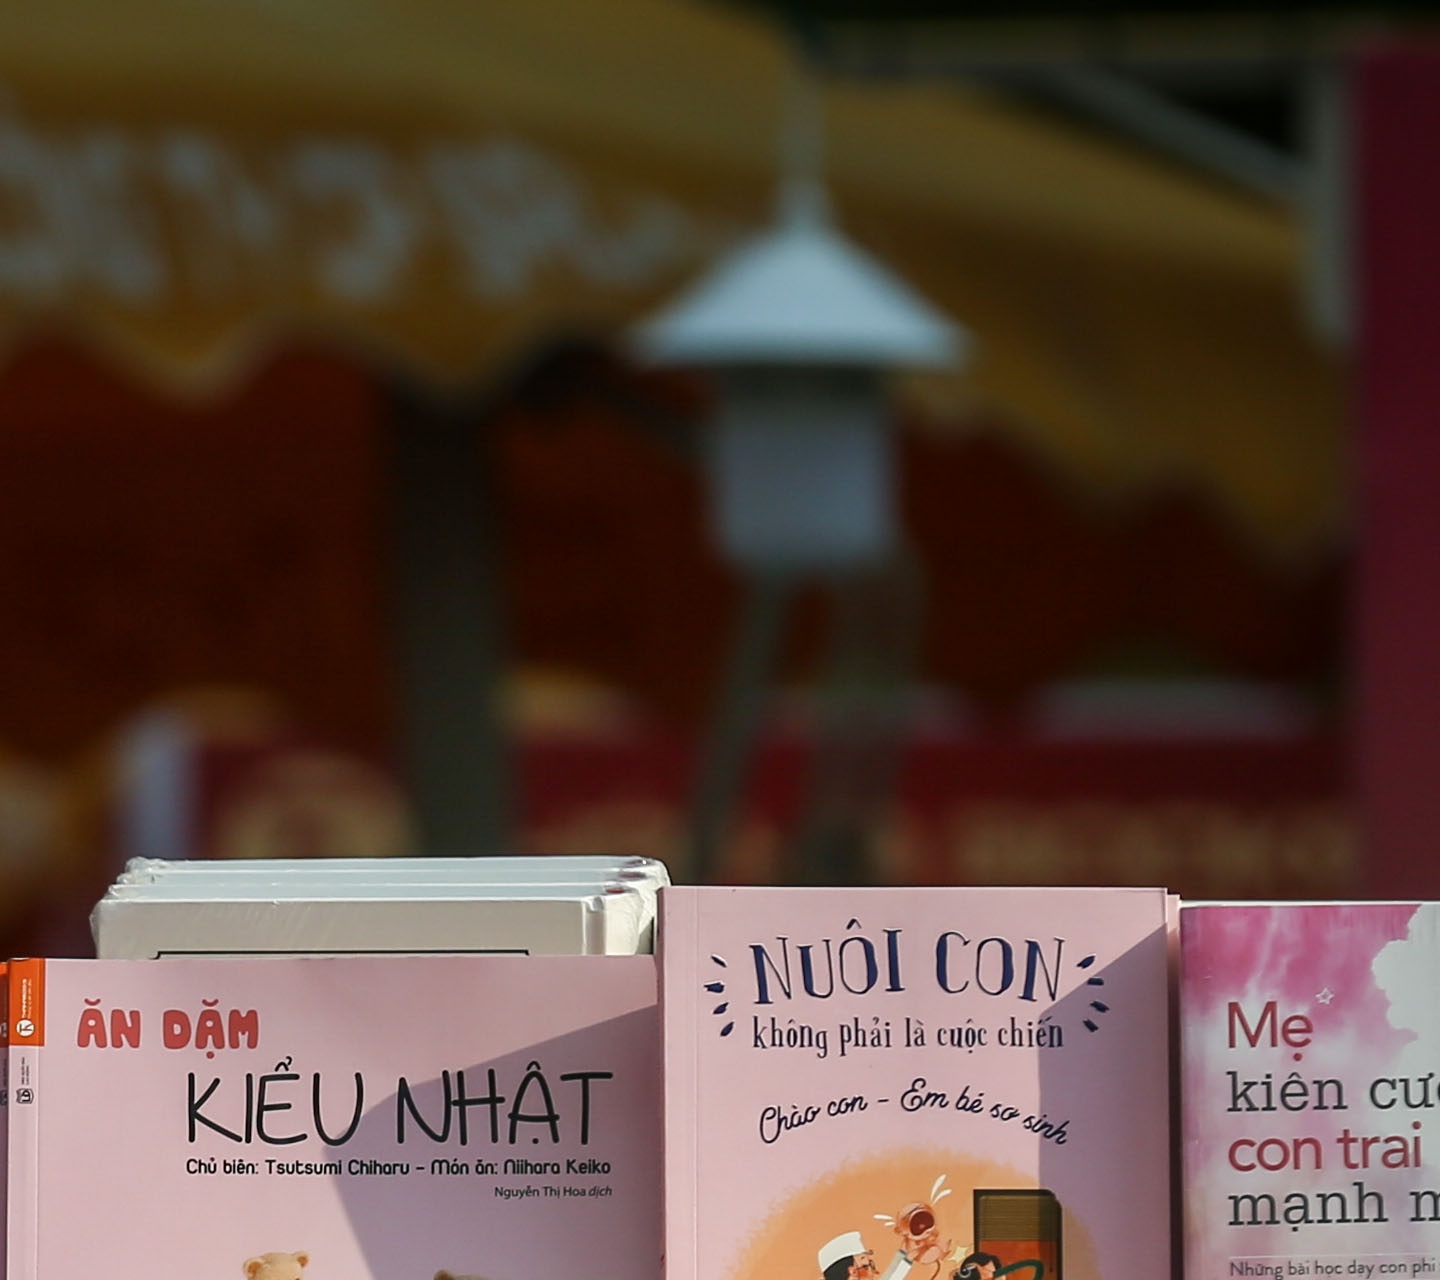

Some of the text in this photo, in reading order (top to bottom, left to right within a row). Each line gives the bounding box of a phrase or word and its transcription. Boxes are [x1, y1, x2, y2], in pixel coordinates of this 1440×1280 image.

[749, 919, 1065, 1005] NUÔI CON
[77, 998, 259, 1059] ĂN DẶM
[752, 1013, 1064, 1058] không phải là cuộc chiến
[1227, 1001, 1314, 1062] Mẹ
[187, 1056, 613, 1145] KIỂU NHẬT
[760, 1106, 821, 1145] Chào
[826, 1093, 868, 1120] con
[900, 1077, 948, 1112] Em
[956, 1086, 984, 1115] bé
[1023, 1114, 1069, 1145] sinh
[1226, 1071, 1347, 1112] kiên
[186, 1157, 217, 1175] Chủ
[223, 1157, 259, 1175] biên:
[266, 1159, 342, 1176] Tsutsumi
[347, 1159, 410, 1176] Chiharu
[431, 1157, 469, 1176] Món
[475, 1159, 499, 1176] ăn:
[565, 1159, 611, 1175] Keiko
[1228, 1121, 1422, 1172] con trai
[494, 1184, 612, 1200] Nguyễn Thị Hoa dịch
[1228, 1182, 1388, 1232] mạnh
